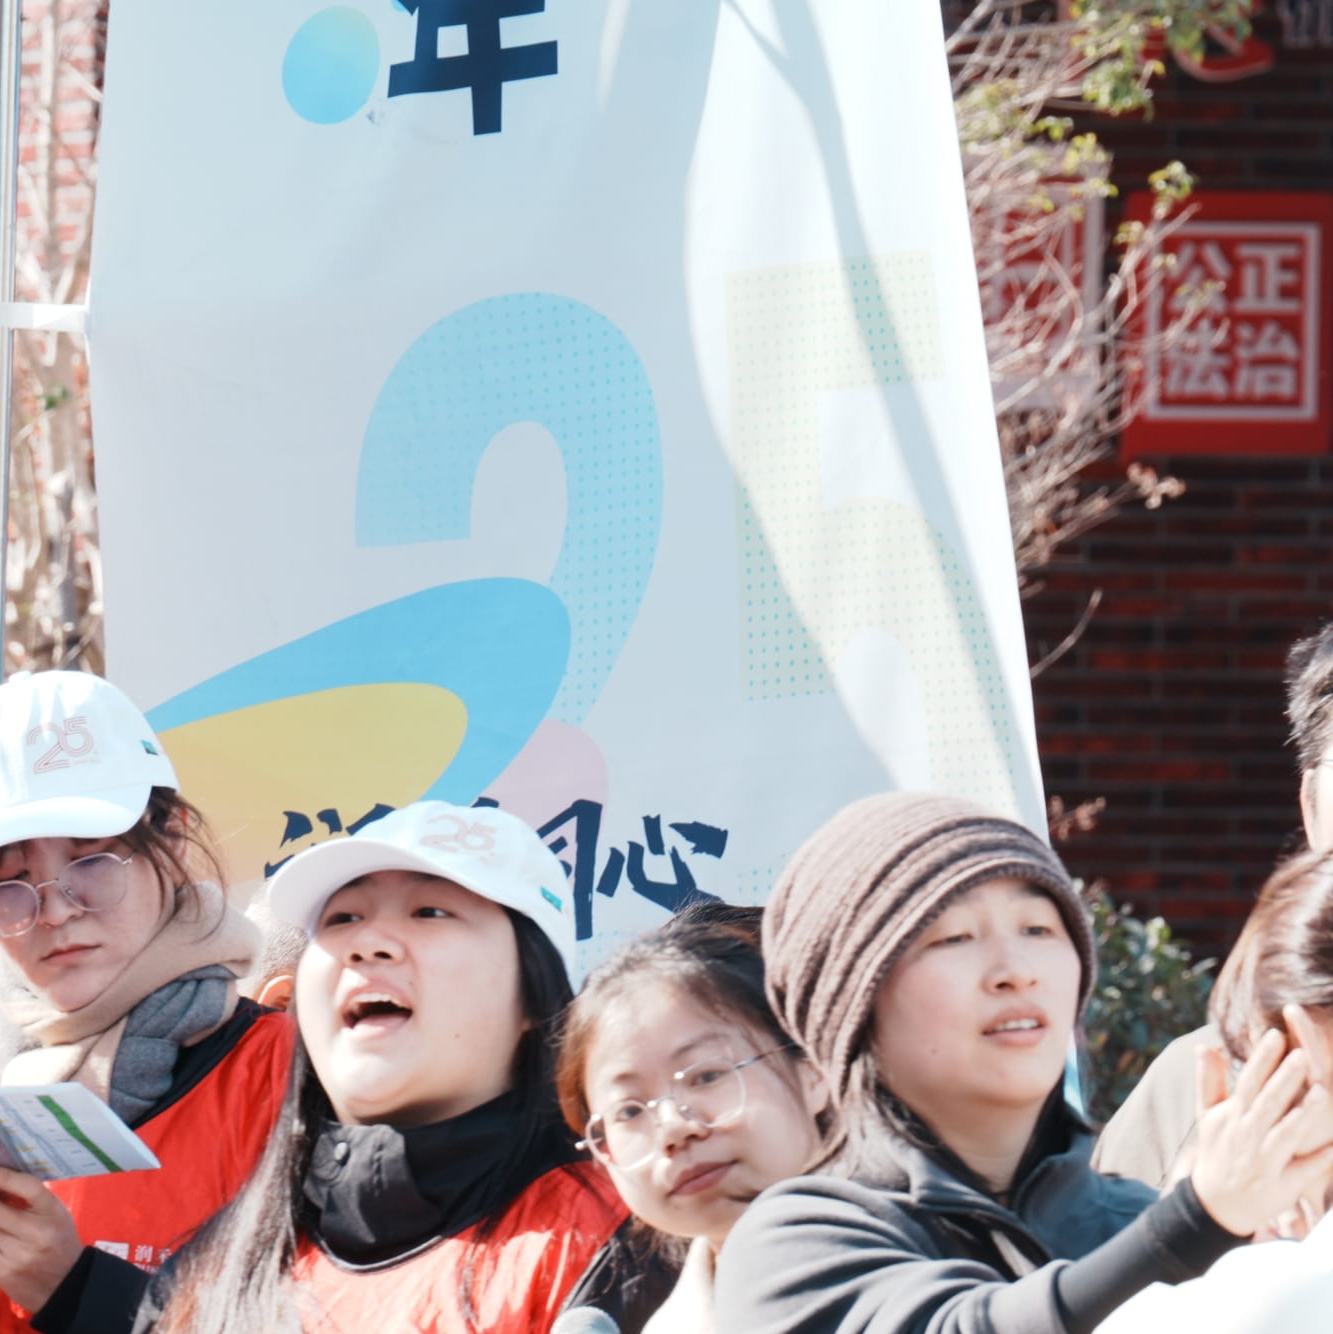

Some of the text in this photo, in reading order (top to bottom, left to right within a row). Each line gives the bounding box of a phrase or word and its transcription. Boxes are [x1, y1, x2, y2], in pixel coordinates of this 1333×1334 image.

[1169, 241, 1301, 316] 公正
[1165, 317, 1301, 398] 法治
[26, 715, 95, 775] 25
